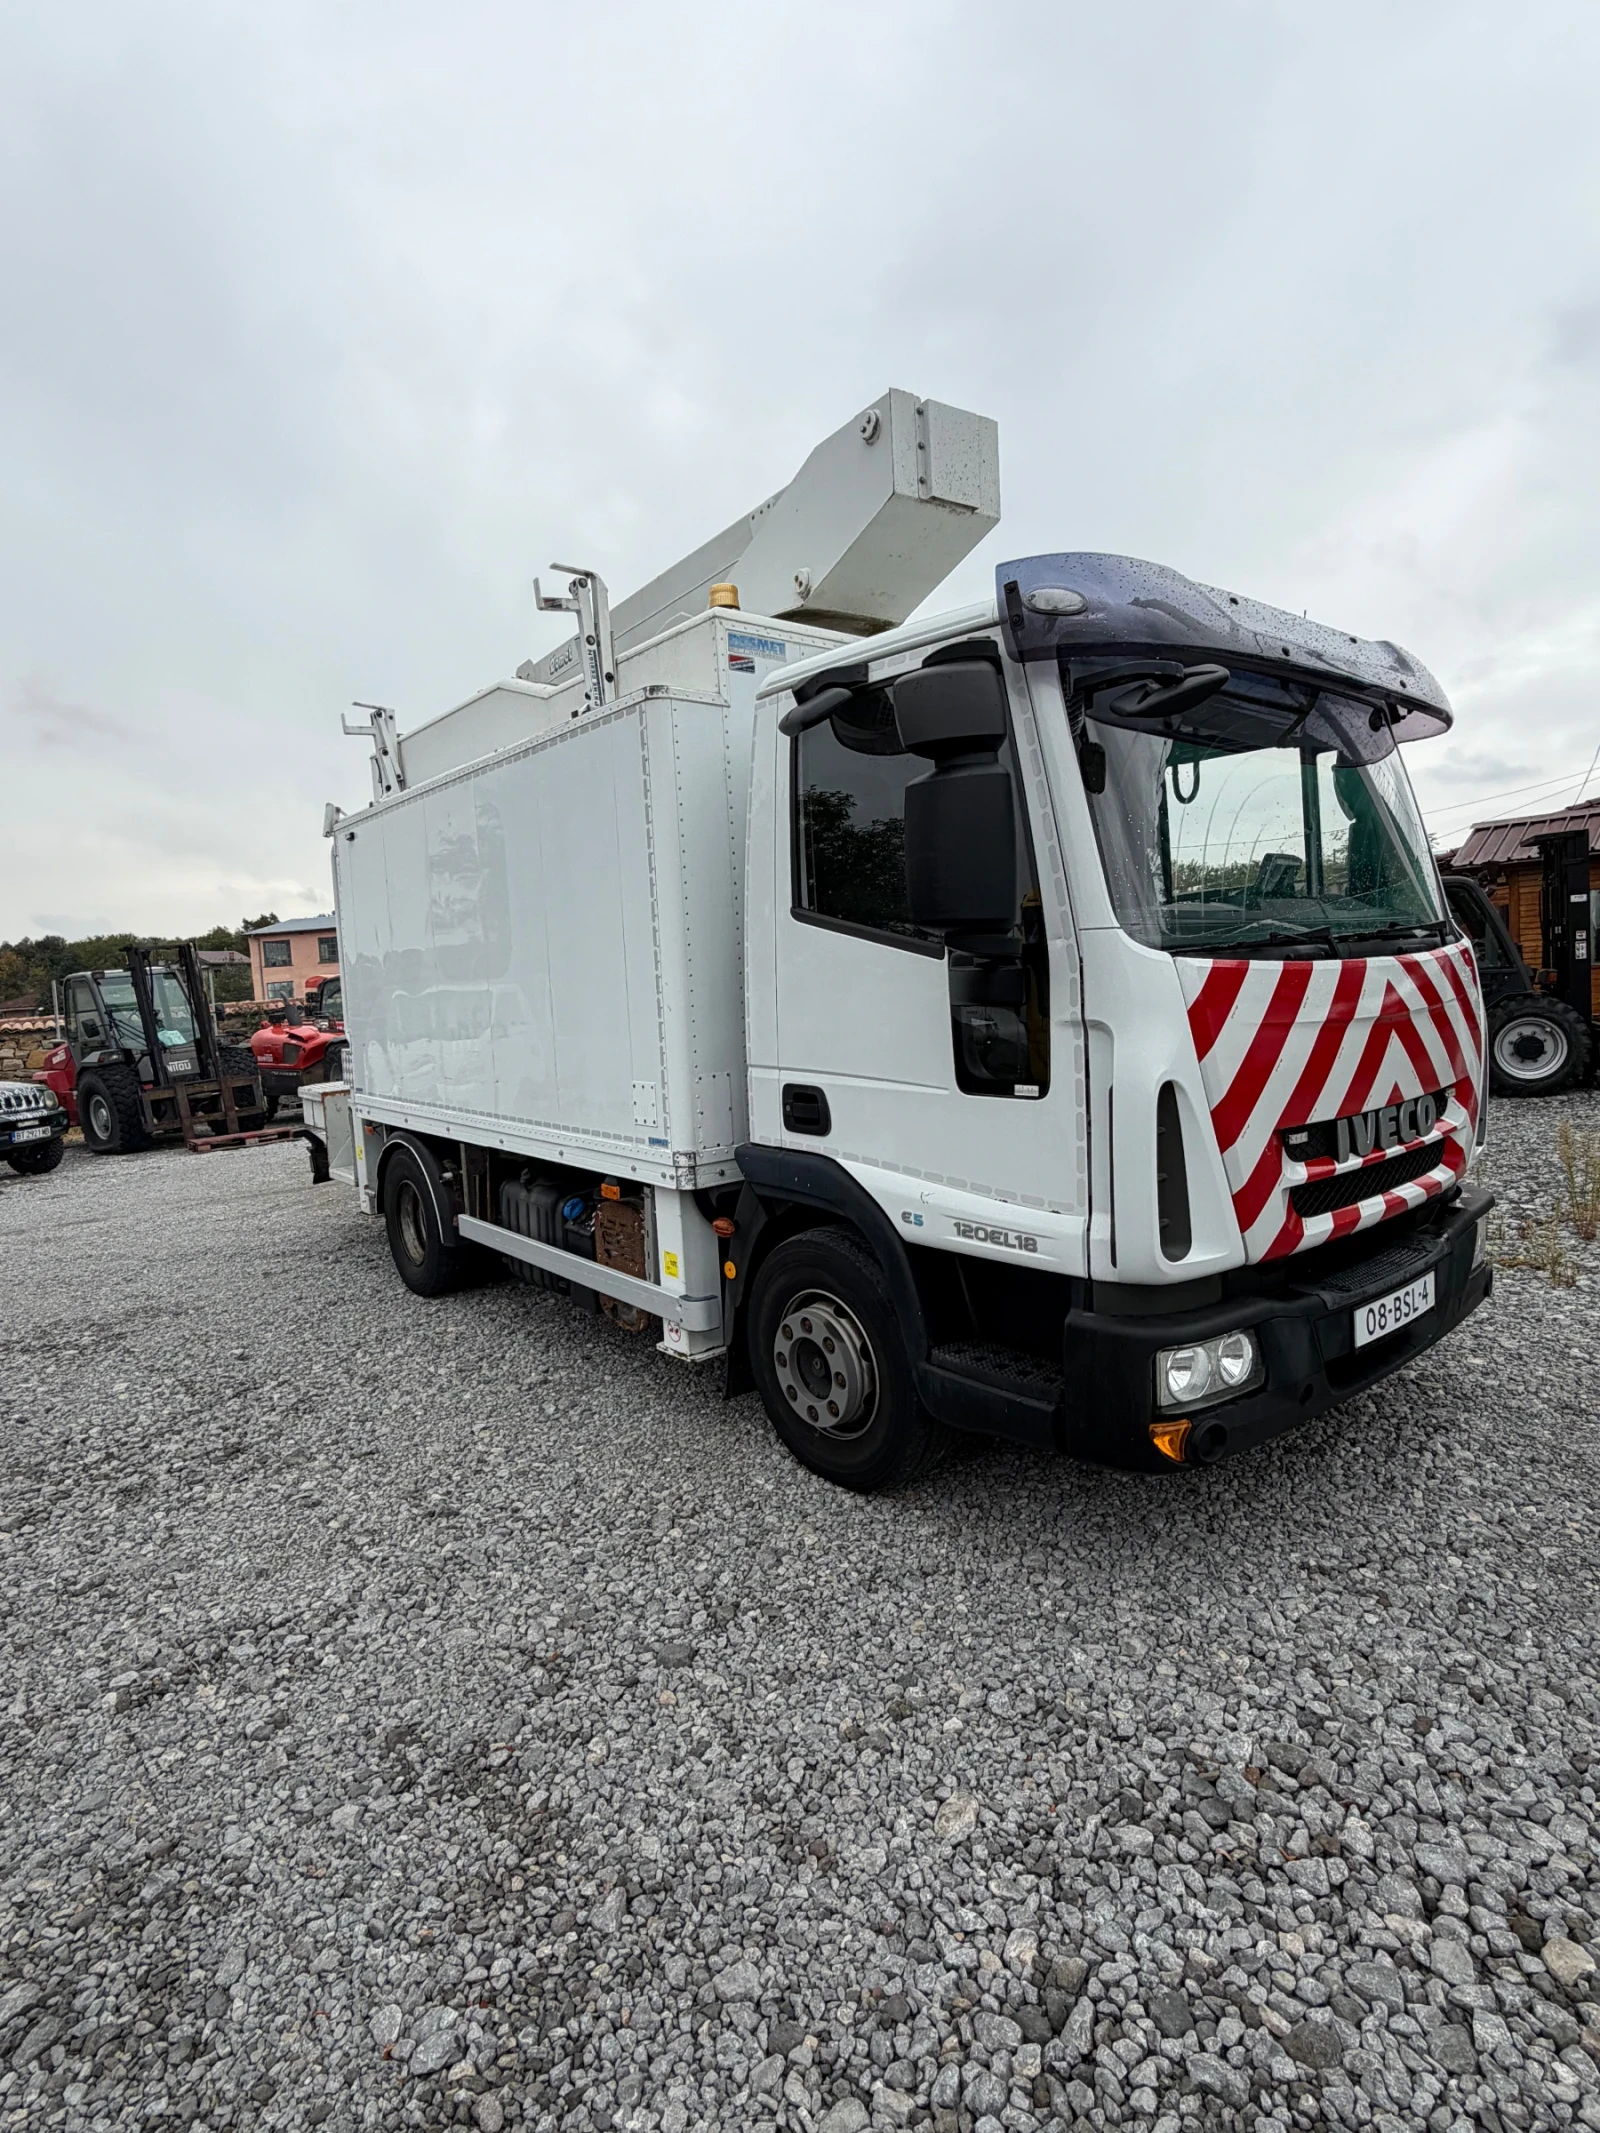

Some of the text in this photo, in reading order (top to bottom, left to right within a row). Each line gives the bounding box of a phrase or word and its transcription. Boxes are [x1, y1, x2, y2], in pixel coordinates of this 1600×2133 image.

[587, 649, 597, 680] DESIGN
[1337, 1095, 1437, 1164] IVECO
[901, 1211, 924, 1227] E5
[953, 1222, 1038, 1253] 120EL18
[1366, 1279, 1428, 1336] 08-BSL-4
